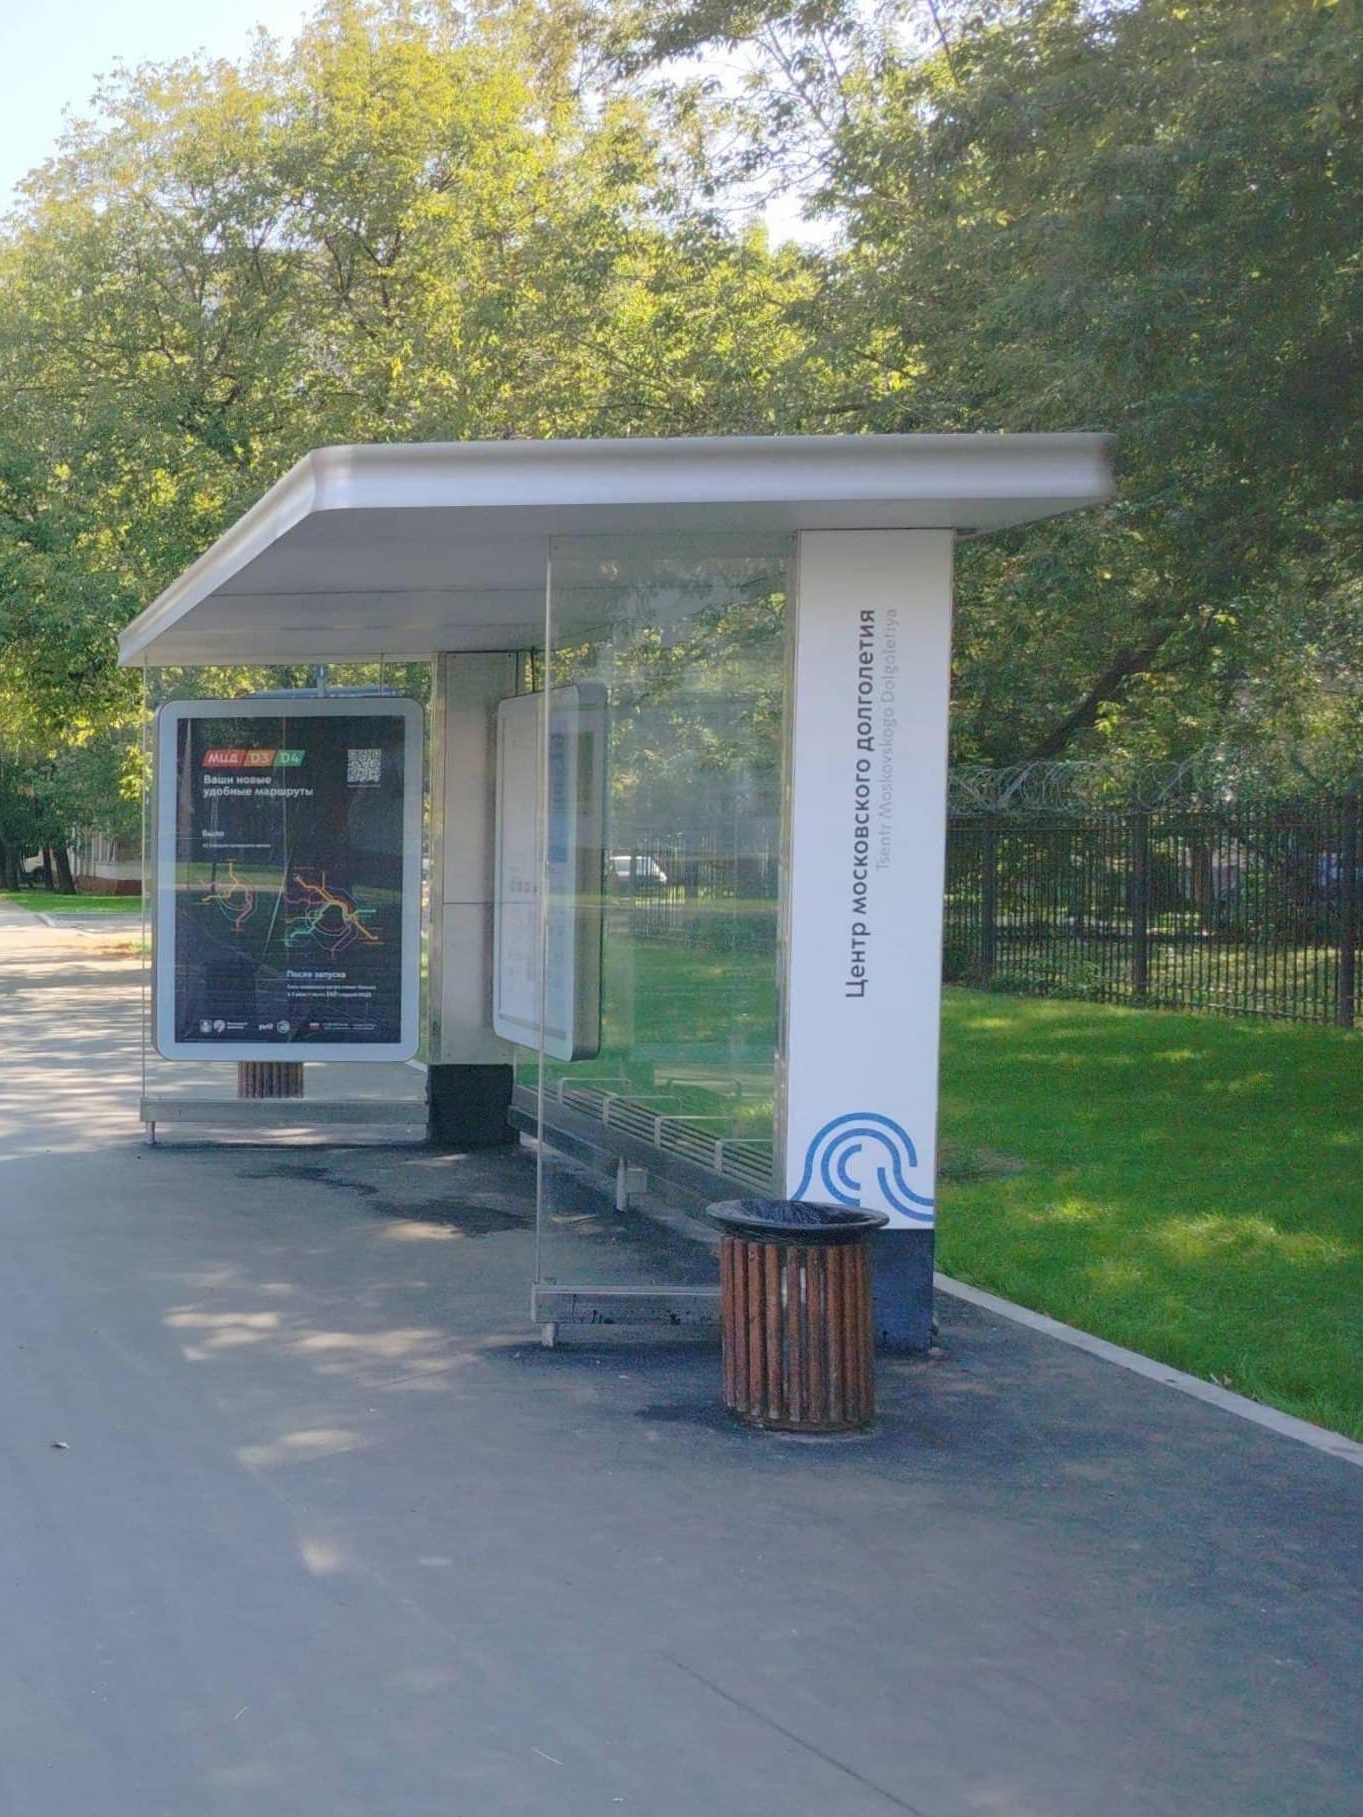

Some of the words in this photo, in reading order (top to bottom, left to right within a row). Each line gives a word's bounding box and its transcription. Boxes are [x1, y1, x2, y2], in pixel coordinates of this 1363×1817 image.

[857, 610, 875, 751] долголетия
[882, 608, 898, 702] Dolgoletiya
[202, 786, 252, 798] удобные
[254, 787, 314, 798] маршруты
[203, 774, 234, 785] Ваши
[236, 775, 272, 785] новые
[878, 707, 897, 817] Moskovskogo
[852, 759, 871, 914] московского
[877, 822, 891, 871] Tsentr
[845, 922, 871, 998] Центр
